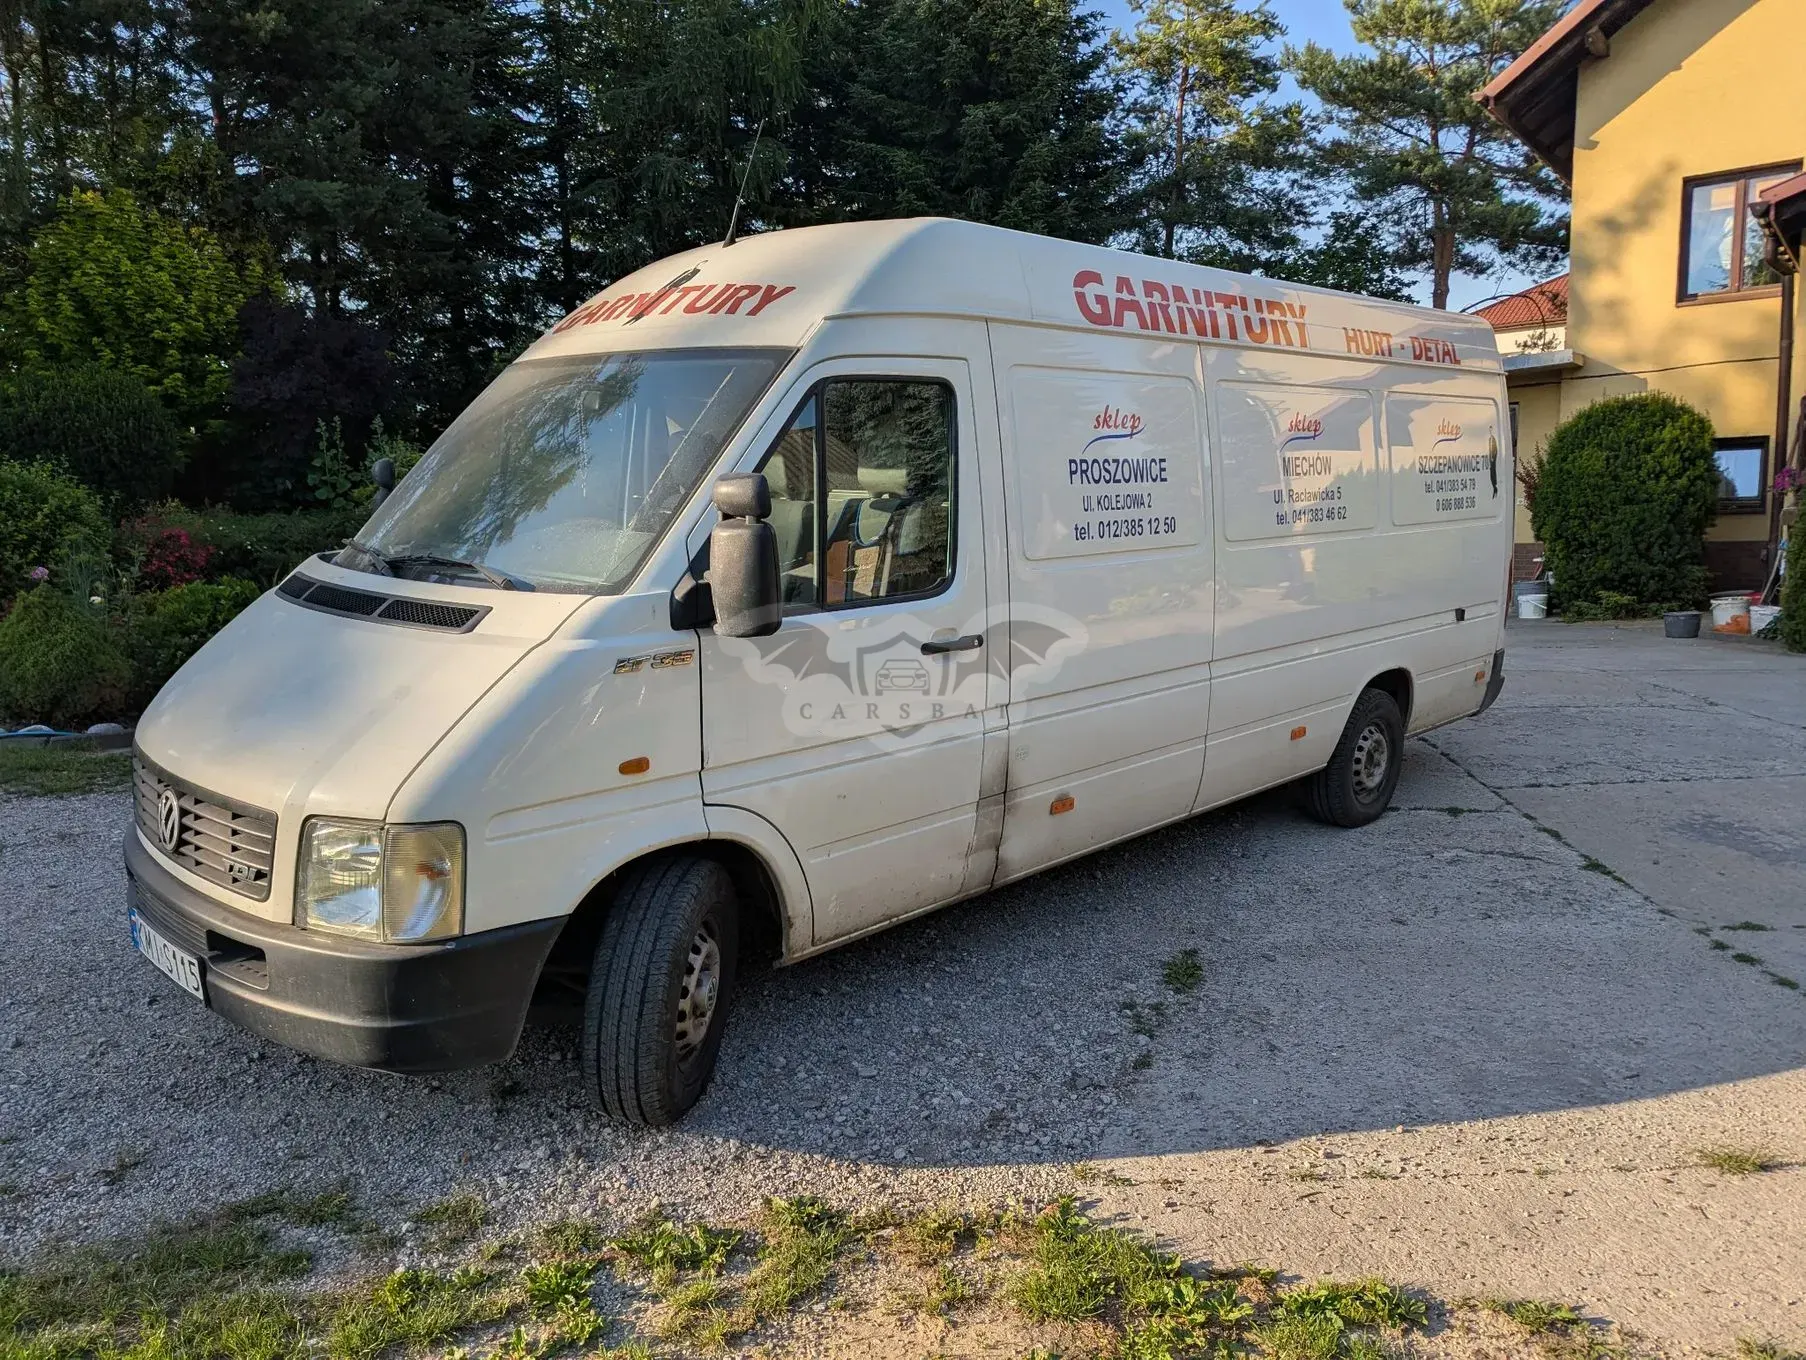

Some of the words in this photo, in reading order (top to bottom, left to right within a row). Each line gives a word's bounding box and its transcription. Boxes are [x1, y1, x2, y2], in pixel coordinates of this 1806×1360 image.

[553, 284, 796, 334] GARNITURY
[1073, 269, 1311, 348] GARNITURY
[1343, 327, 1393, 358] HURT
[1409, 336, 1462, 365] DETAL
[1094, 405, 1141, 439] sklep
[1288, 412, 1321, 440] sklep
[1437, 418, 1461, 440] sklep
[1068, 458, 1168, 485] PROSZOWICE
[1282, 452, 1332, 476] MIECHÓW
[1418, 455, 1480, 474] SZCZEPANOWICE
[1336, 486, 1342, 500] 5
[1424, 480, 1435, 493] tel.
[1097, 493, 1146, 512] KOLEJOWA
[1147, 493, 1153, 509] 2
[1276, 511, 1290, 526] tel.
[1292, 507, 1324, 524] 041/383
[1325, 507, 1335, 521] 46
[1337, 506, 1347, 520] 62
[1074, 522, 1094, 541] tel.
[1098, 518, 1144, 539] 012/385
[1148, 517, 1160, 535] 12
[1163, 516, 1176, 534] 50
